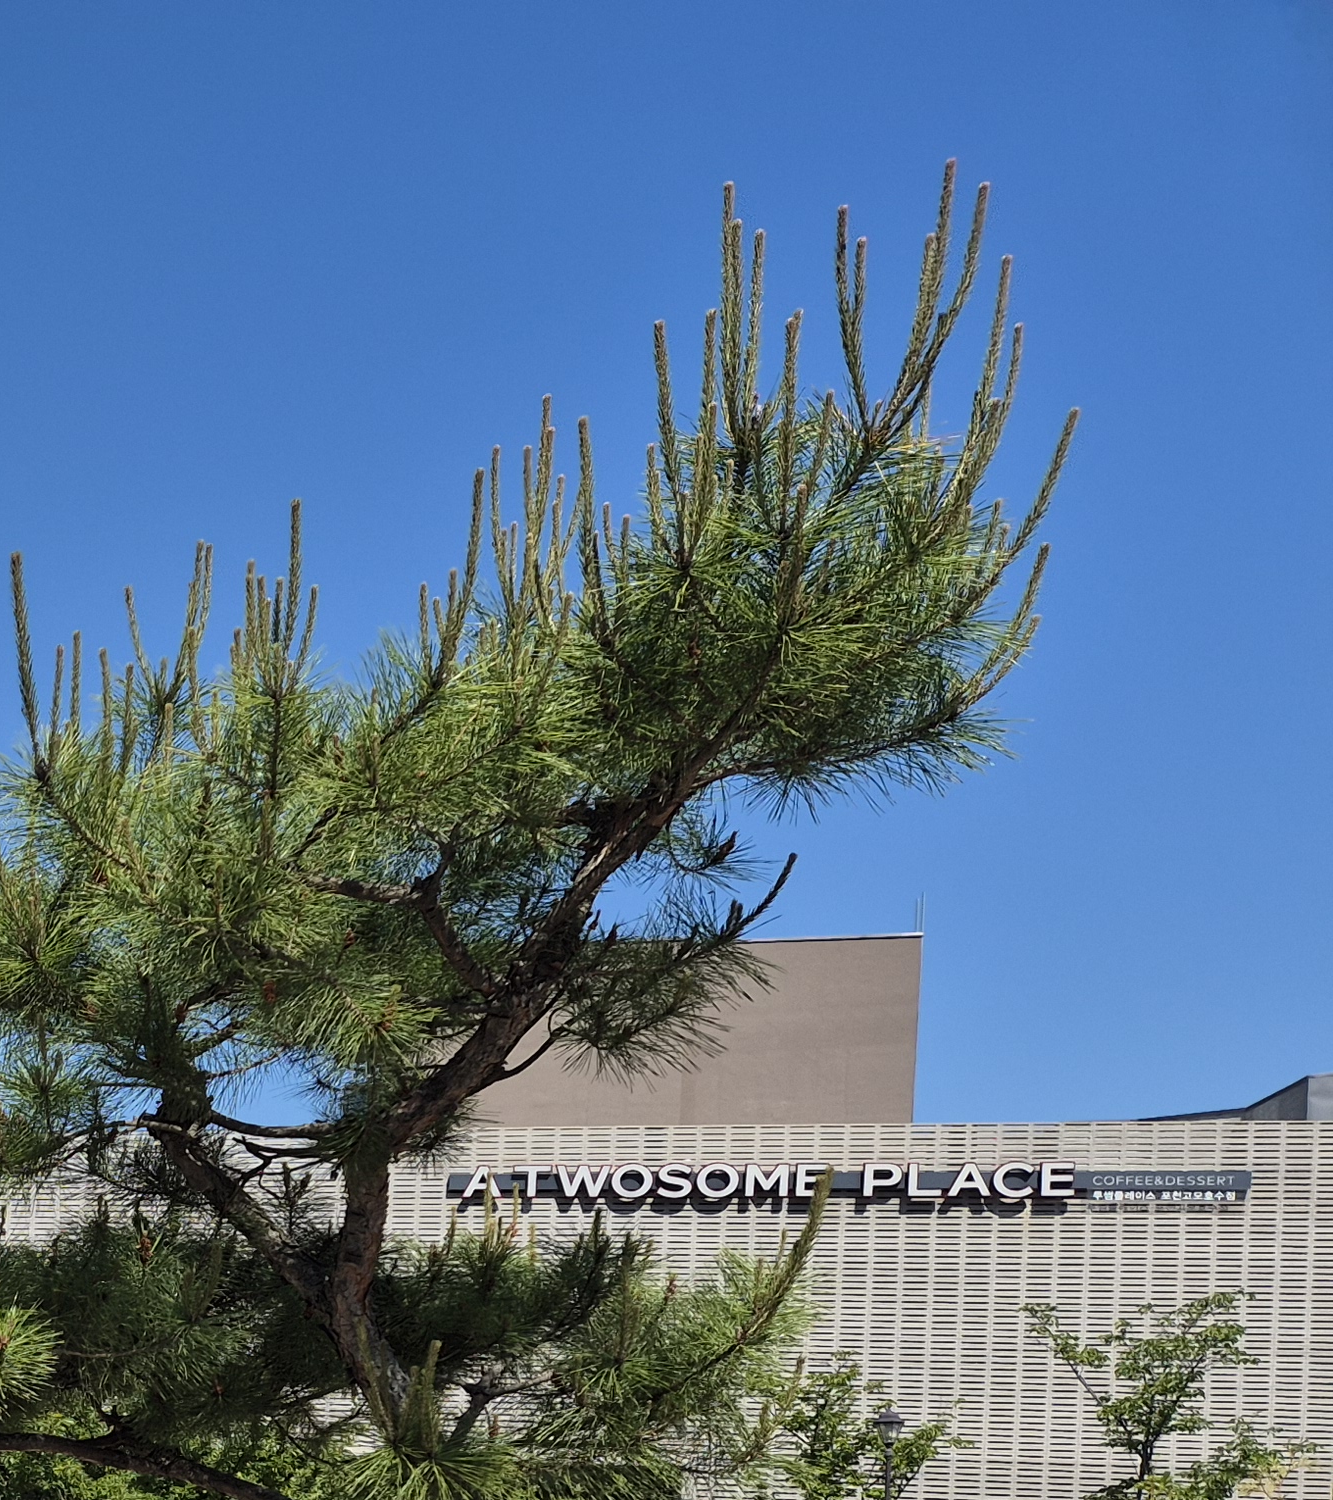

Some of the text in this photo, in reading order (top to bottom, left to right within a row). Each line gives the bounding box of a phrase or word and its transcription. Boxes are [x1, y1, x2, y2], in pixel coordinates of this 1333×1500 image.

[462, 1161, 1076, 1200] A TWOSOME PLACE
[1092, 1174, 1236, 1187] COFFEE&DESSERT
